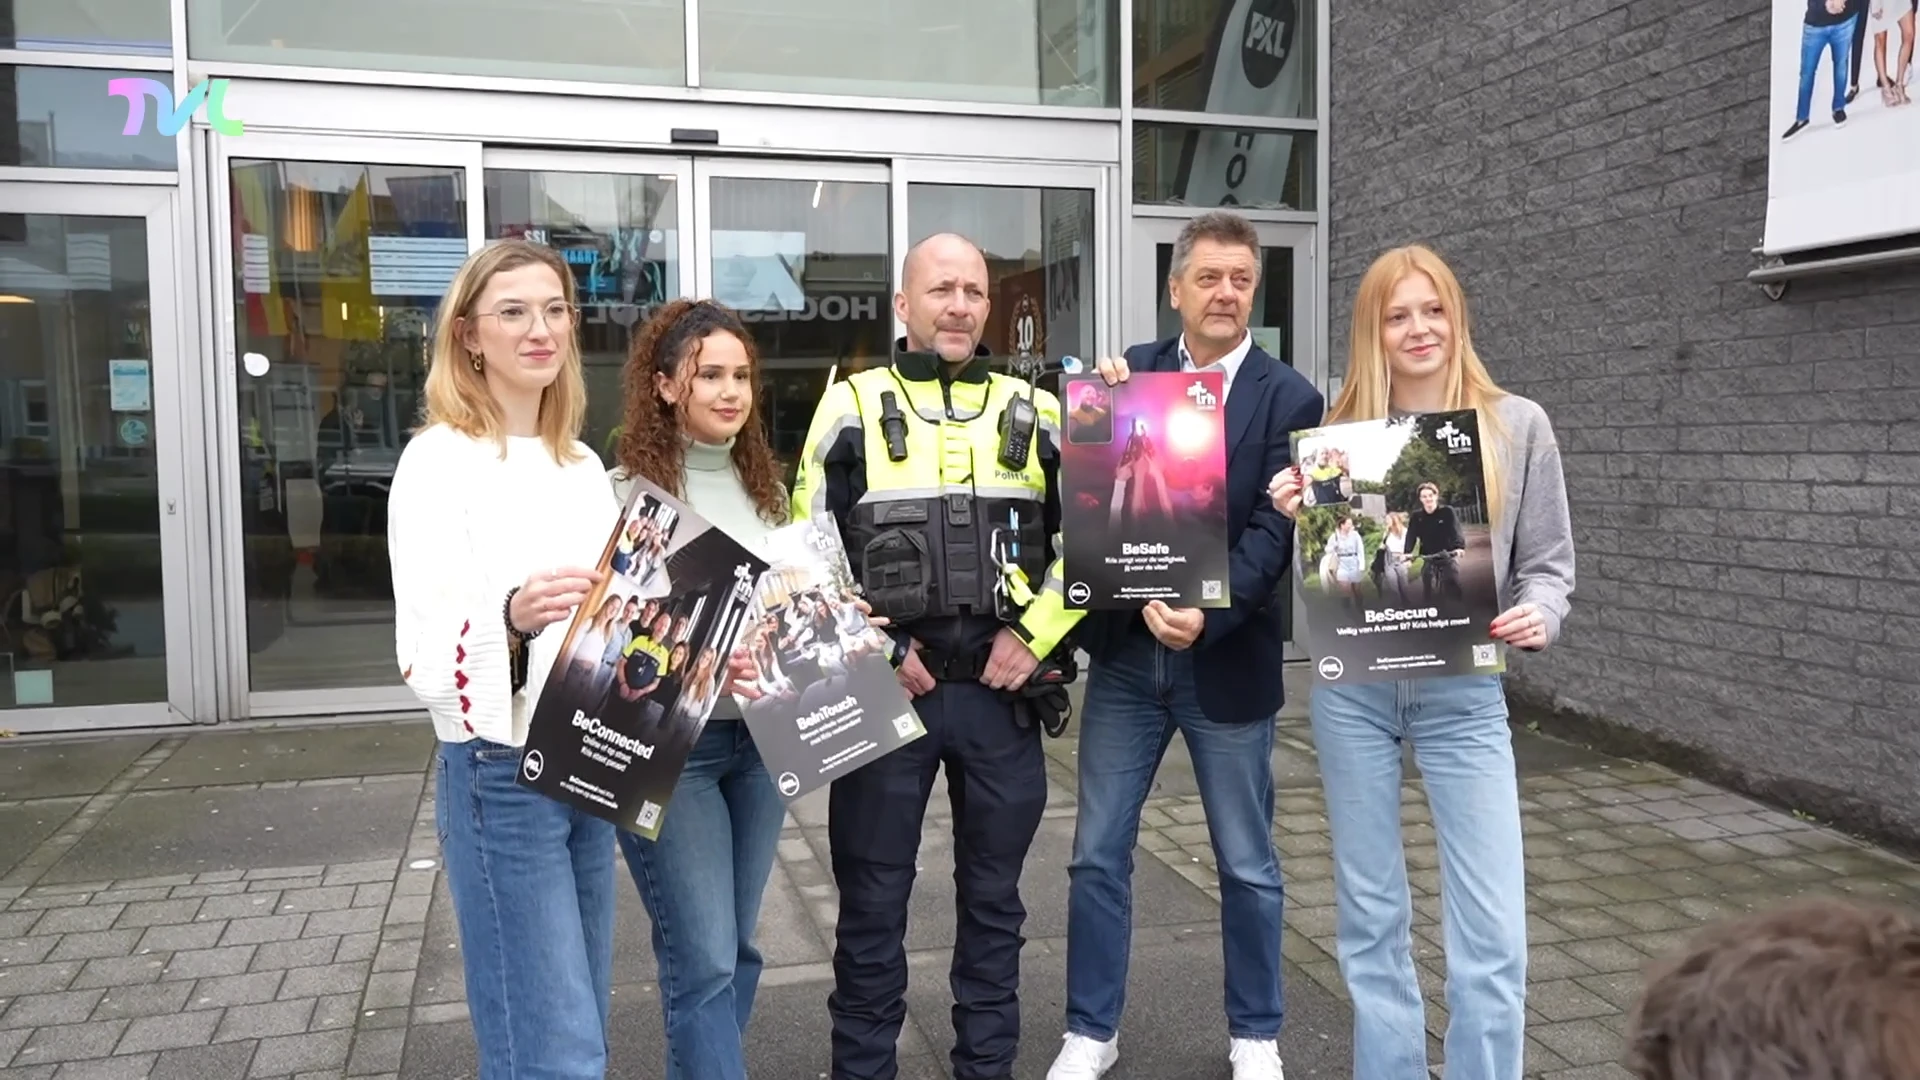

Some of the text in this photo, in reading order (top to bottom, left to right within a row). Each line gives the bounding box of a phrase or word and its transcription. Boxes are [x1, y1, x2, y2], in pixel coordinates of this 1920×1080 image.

[1245, 11, 1286, 59] PXL
[995, 470, 1030, 482] Politie
[1122, 543, 1170, 555] BeSafe
[1364, 607, 1438, 624] BeSecure
[1336, 627, 1358, 636] Veilig
[1359, 627, 1373, 635] van
[1373, 625, 1381, 633] A
[1412, 620, 1428, 629] Kris
[1428, 619, 1449, 629] helpt
[1450, 617, 1470, 626] mee!
[796, 695, 857, 730] BeInTouch
[572, 709, 655, 760] BeConnected
